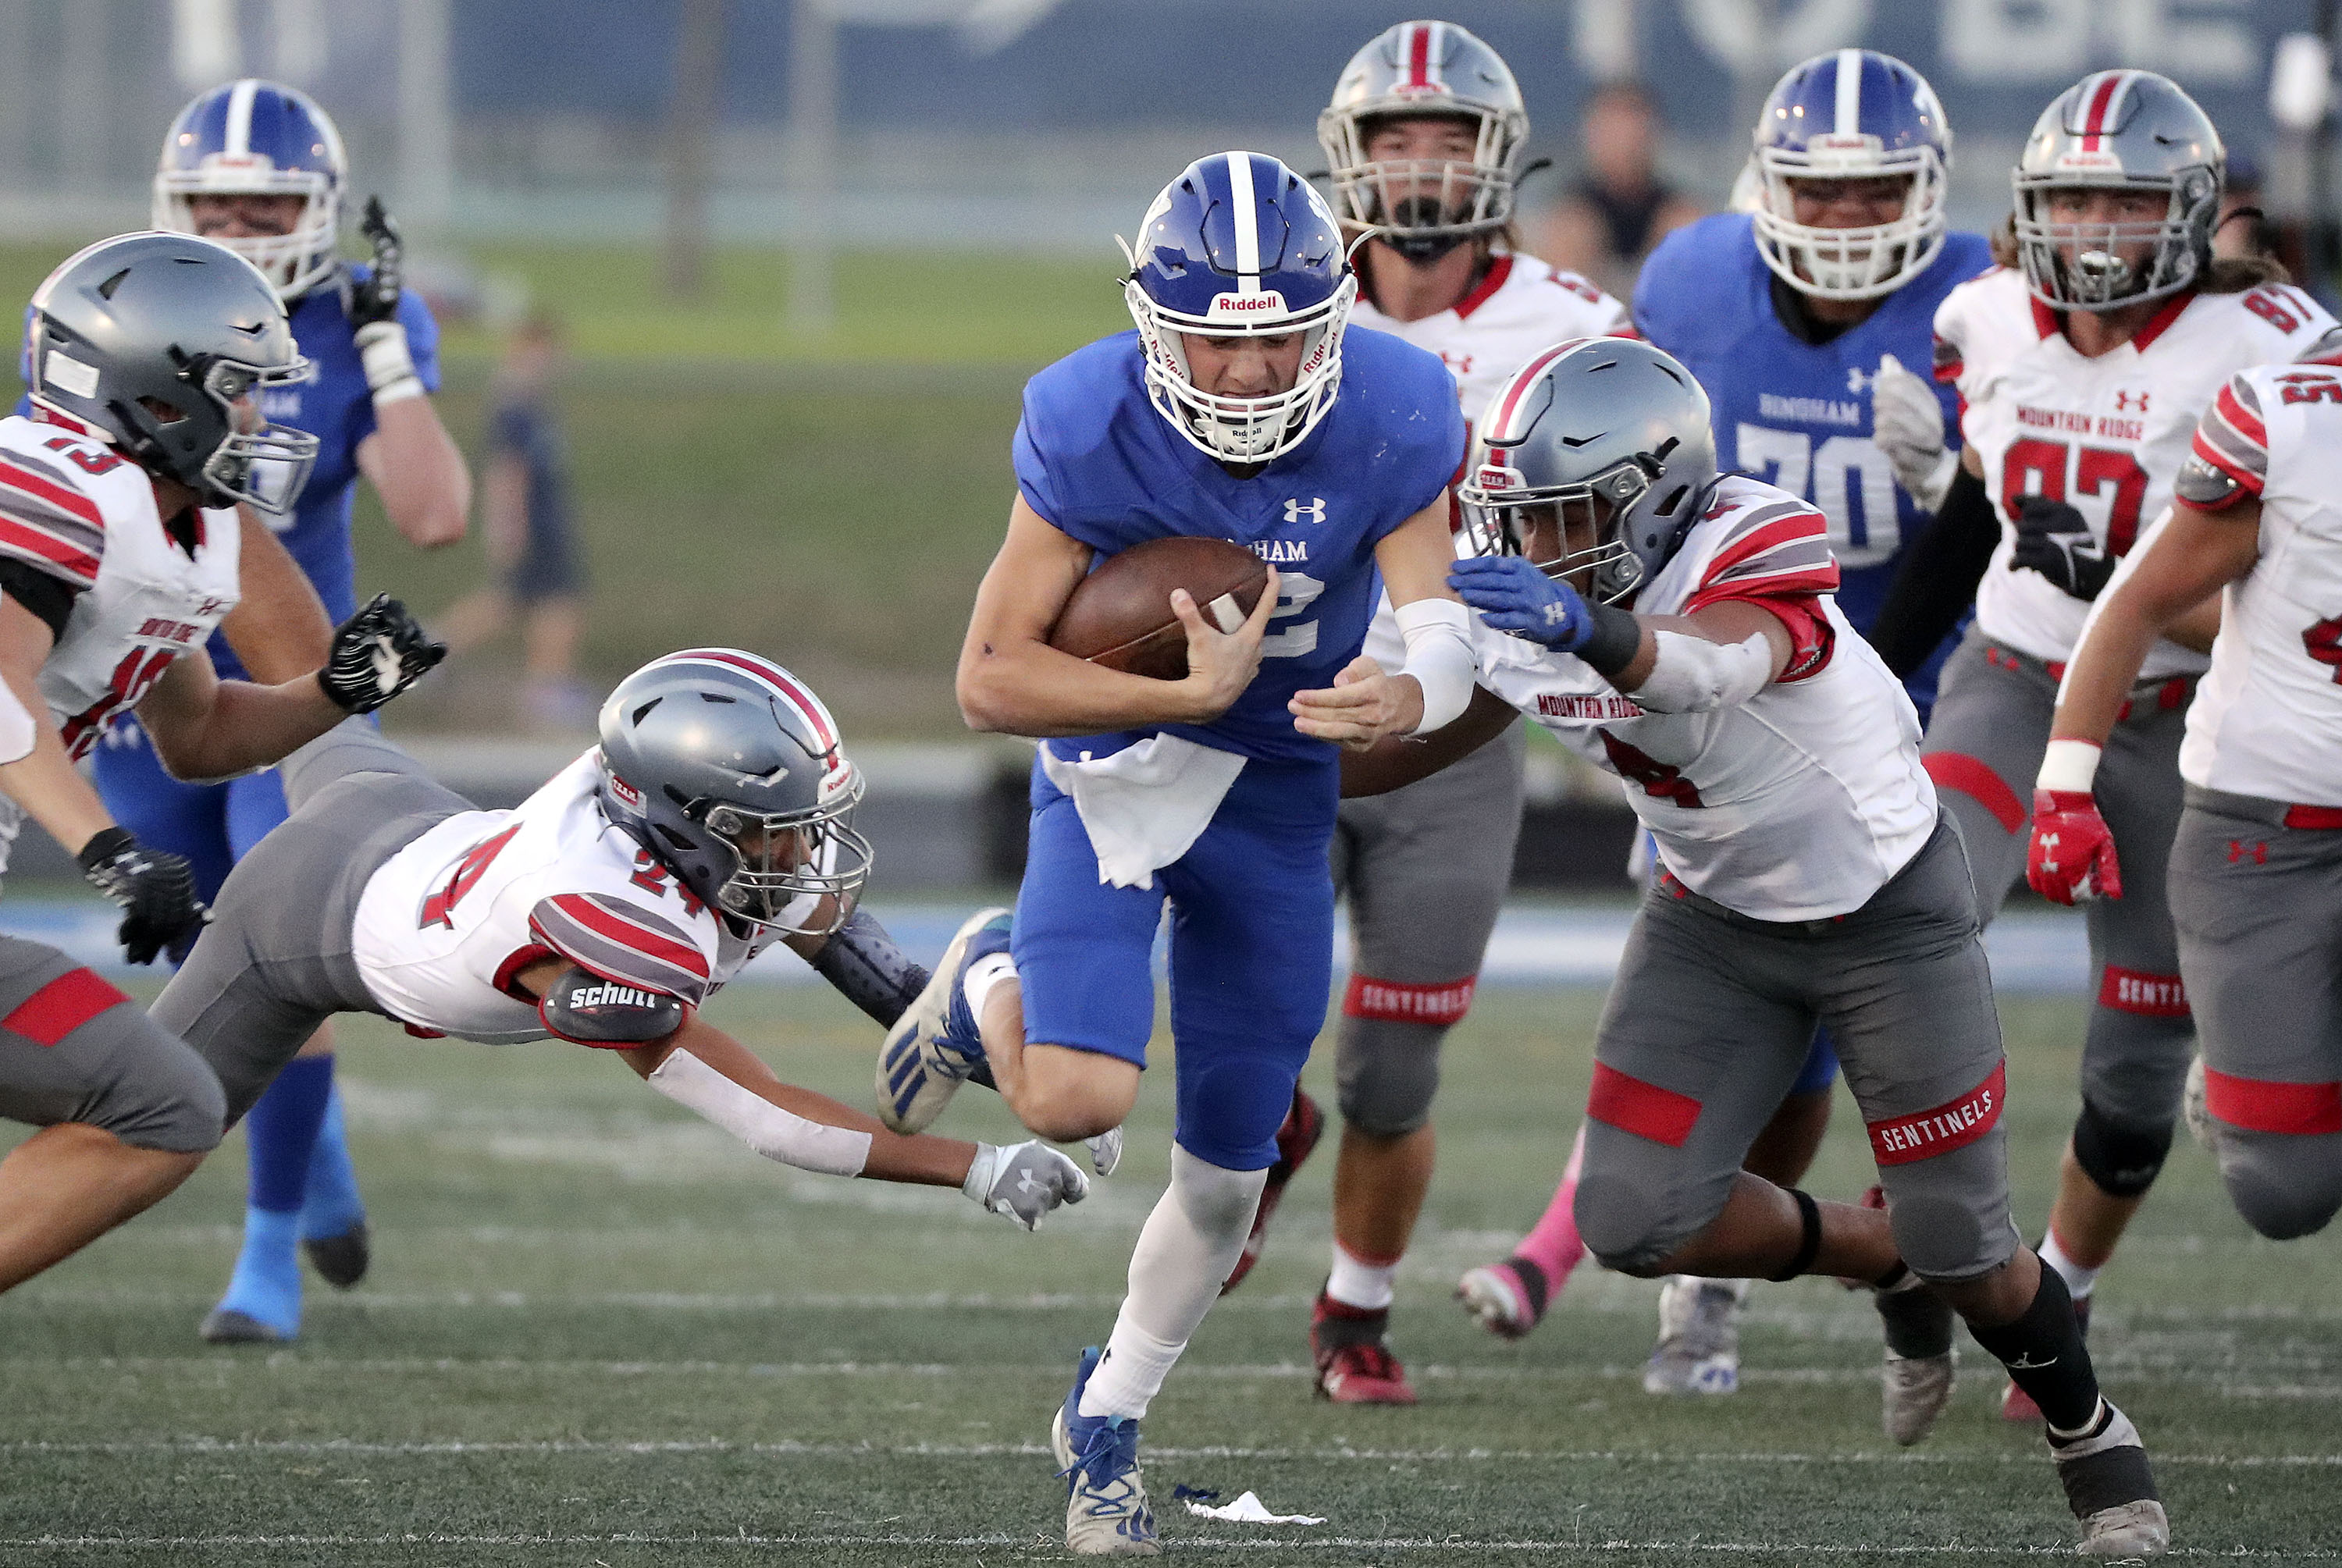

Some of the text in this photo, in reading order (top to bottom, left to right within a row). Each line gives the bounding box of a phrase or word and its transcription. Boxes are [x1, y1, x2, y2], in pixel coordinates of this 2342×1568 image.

[1219, 296, 1277, 311] Riddell
[1736, 422, 1902, 569] 70
[1361, 984, 1472, 1015] SENTINELS
[2118, 976, 2191, 1006] SENTI
[1881, 1090, 1993, 1152] SENTINELS
